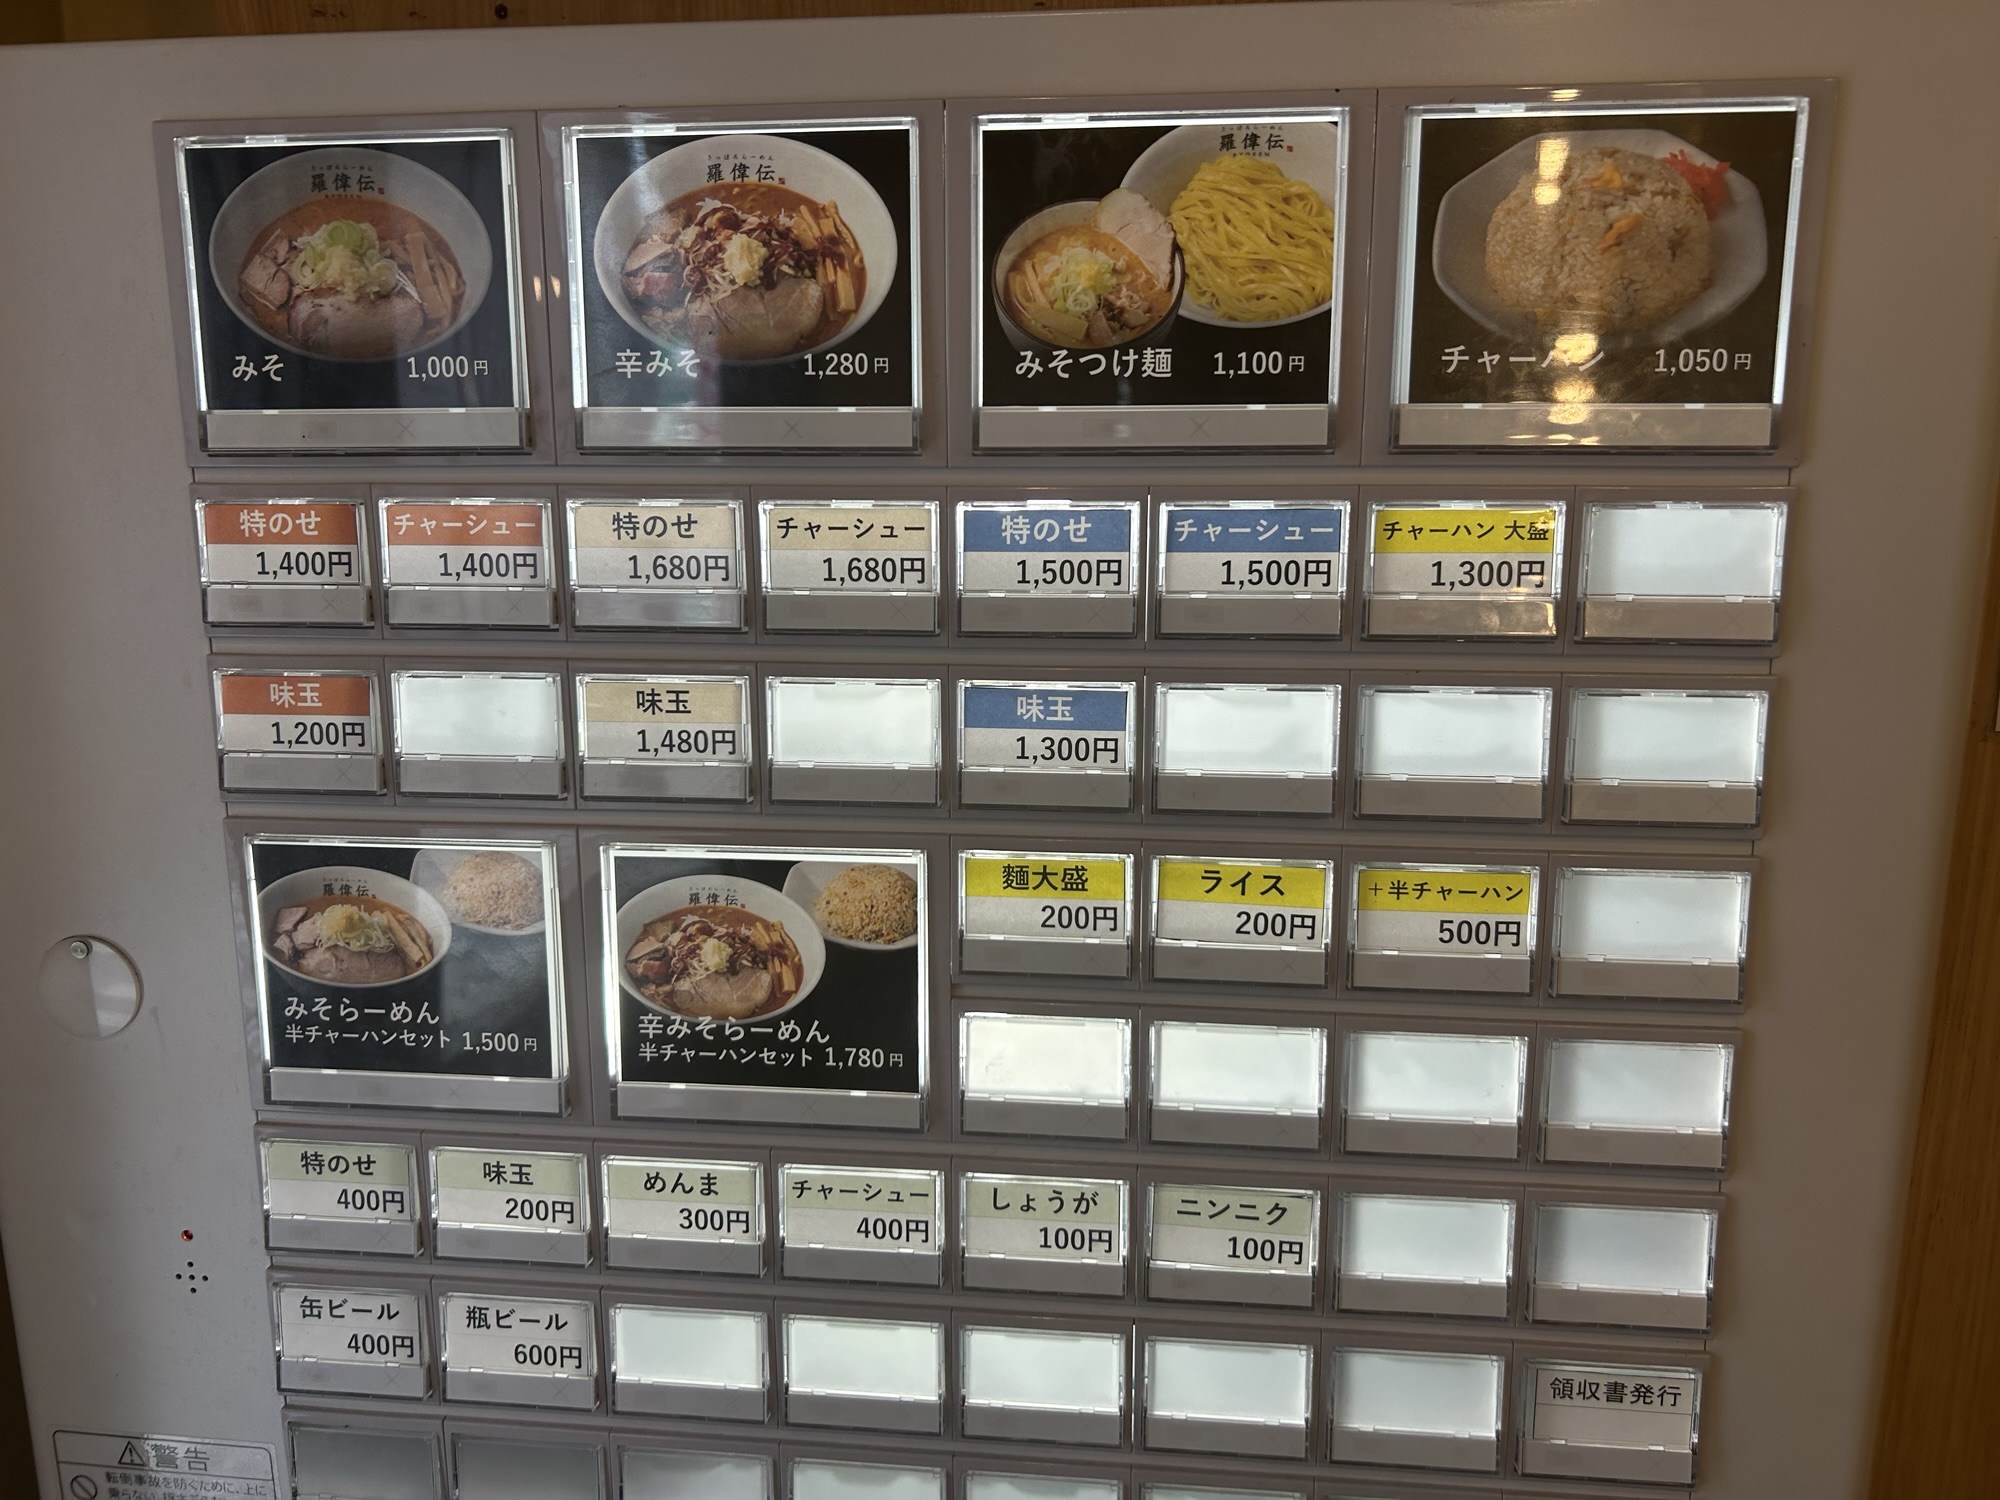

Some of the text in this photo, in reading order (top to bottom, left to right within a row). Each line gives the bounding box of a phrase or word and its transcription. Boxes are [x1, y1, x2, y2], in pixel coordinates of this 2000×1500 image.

[1219, 132, 1285, 152] 羅偉伝
[311, 173, 375, 192] 羅偉伝
[706, 162, 775, 183] 羅偉伝
[231, 353, 488, 382] みそ 1,000円
[615, 348, 888, 379] 辛みそ 1,280円
[1016, 347, 1304, 378] みそつけ麺 1,100円
[1655, 349, 1751, 376] 1,050円
[240, 510, 321, 537] 特のせ
[394, 513, 537, 536] チャーシュー
[612, 512, 697, 540] 特のせ
[777, 518, 925, 539] チャーシュー
[1002, 515, 1091, 544] 特のせ
[1175, 519, 1333, 542] チャーシュー
[1383, 520, 1550, 541] チャーハン 大盛
[257, 552, 352, 579] 1,400円
[439, 553, 537, 581] 1,400円
[629, 555, 729, 583] 1,680円
[823, 558, 925, 586] 1,680円
[1017, 560, 1121, 589] 1,500円
[1222, 560, 1331, 590] 1,500円
[1432, 561, 1544, 591] 1,300円
[270, 682, 322, 708] 味玉
[637, 688, 691, 715] 味玉
[1017, 695, 1073, 722] 味玉
[272, 722, 365, 748] 1,200円
[638, 730, 736, 757] 1,480円
[1016, 737, 1118, 764] 1,300円
[1201, 870, 1284, 896] ライス
[1041, 906, 1117, 931] 200円
[1236, 911, 1315, 940] 200円
[1439, 920, 1520, 946] 500円
[285, 997, 439, 1024] みそらーめん
[285, 1023, 536, 1053] 半チャーハンセット 1,500円
[638, 1013, 831, 1043] 辛みそらーめん
[639, 1042, 902, 1069] 半チャーハンセット 1,780円
[301, 1151, 376, 1175] 特のせ
[483, 1161, 533, 1185] 味玉
[644, 1172, 718, 1196] めんま
[792, 1180, 928, 1202] チャーシュー
[337, 1189, 404, 1213] 400円
[506, 1198, 574, 1224] 200円
[993, 1188, 1099, 1214] しょうが
[1177, 1198, 1289, 1226] ニンニク
[680, 1208, 749, 1233] 300円
[857, 1218, 928, 1243] 400円
[1040, 1227, 1112, 1253] 100円
[1228, 1237, 1303, 1265] 100円
[300, 1296, 399, 1321] 缶ビール
[466, 1305, 568, 1331] 瓶ビール
[348, 1334, 414, 1358] 400円
[515, 1344, 582, 1369] 600円
[1549, 1377, 1682, 1407] 領収書発行
[151, 1443, 209, 1472] 警告
